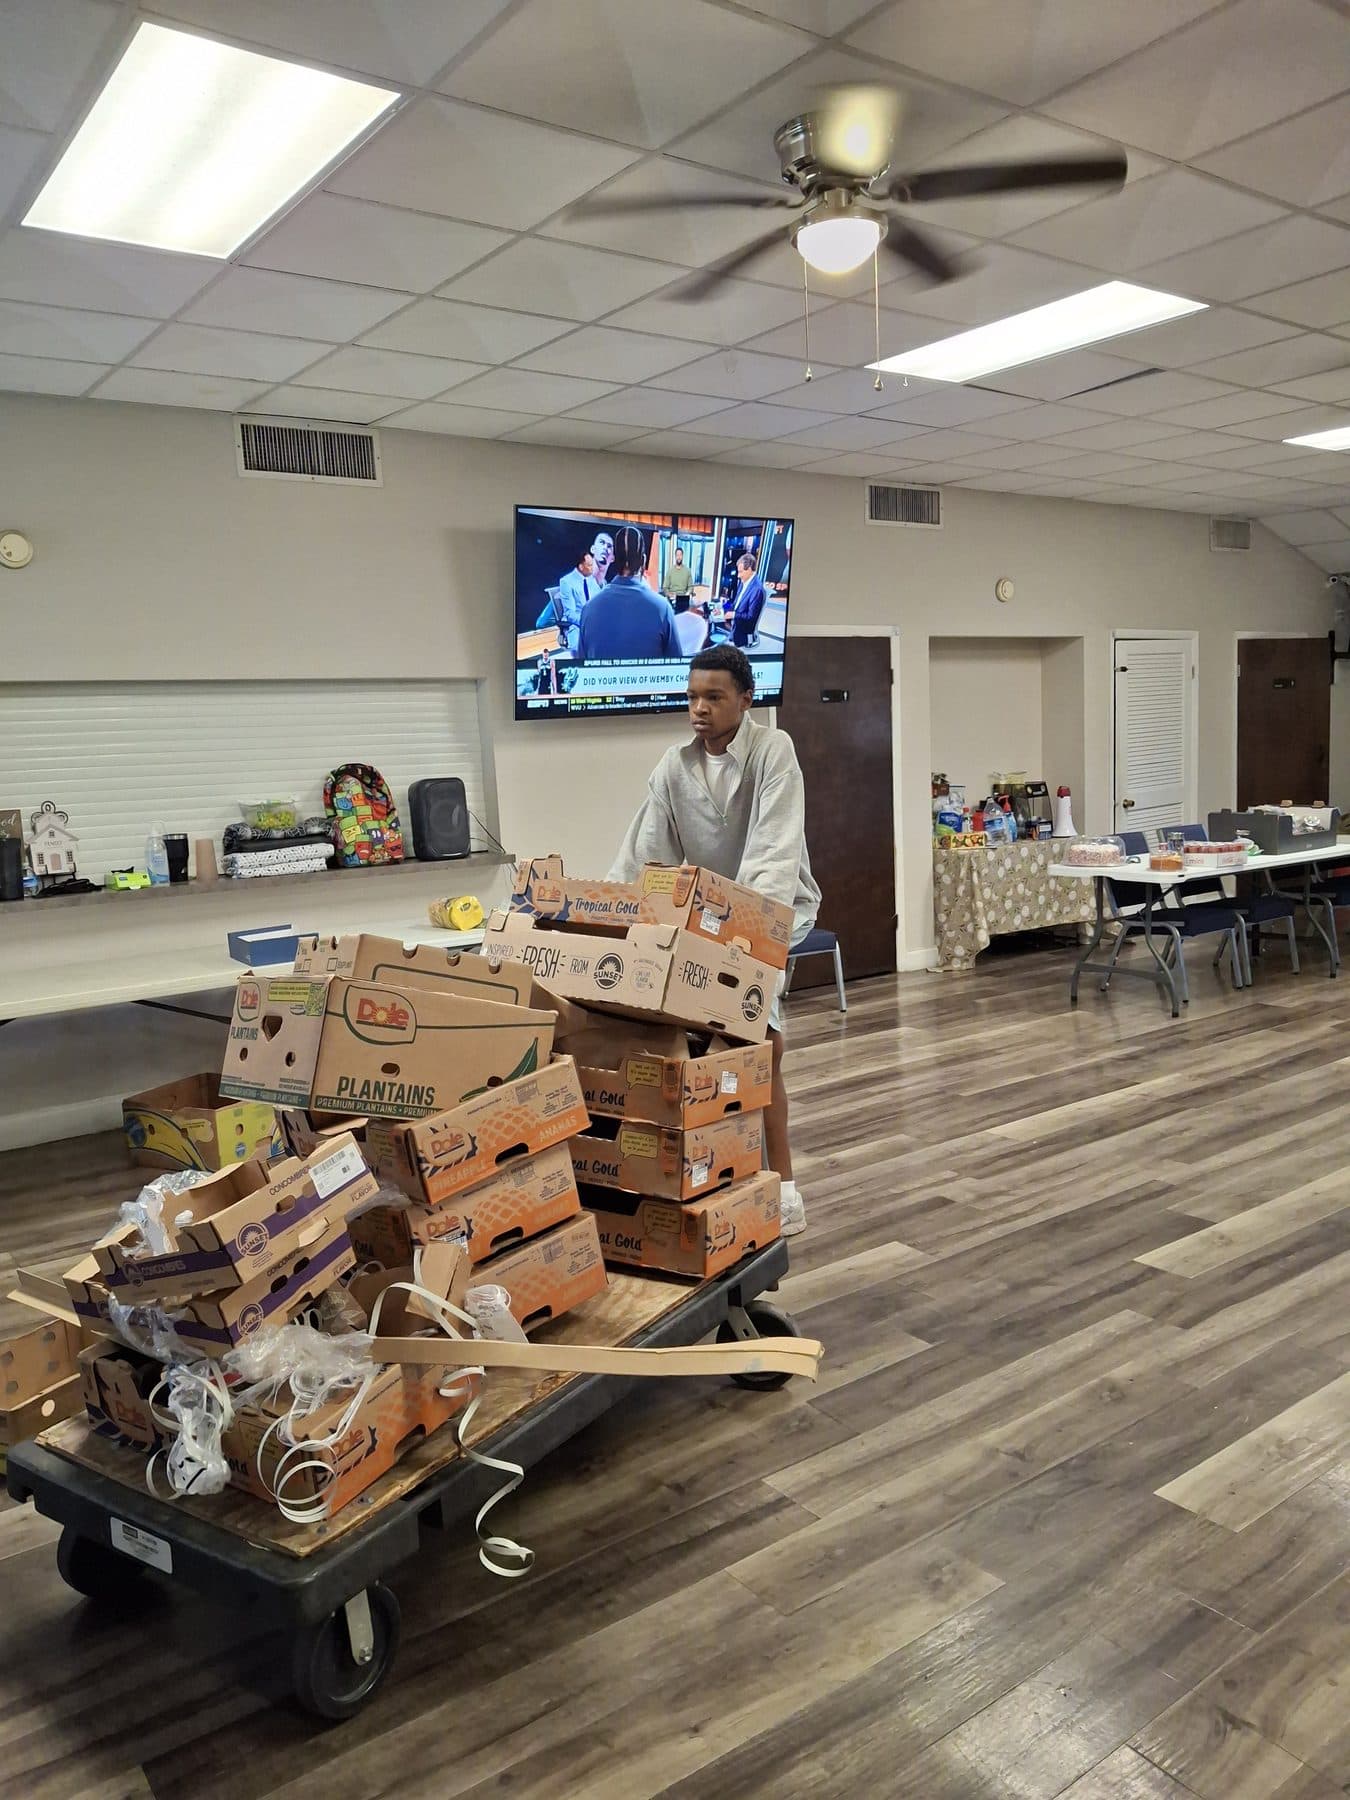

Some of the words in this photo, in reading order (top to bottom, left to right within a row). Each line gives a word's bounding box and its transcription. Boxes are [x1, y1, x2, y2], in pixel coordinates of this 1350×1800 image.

[583, 678, 596, 686] DID
[598, 677, 617, 685] YOUR
[619, 676, 637, 685] VIEW
[639, 676, 648, 684] OF
[650, 675, 673, 683] WEMBY
[538, 885, 561, 899] Dole
[575, 897, 612, 913] Tropical
[615, 900, 640, 915] Gold
[522, 945, 561, 979] FRESH
[569, 958, 589, 975] FROM
[593, 970, 623, 981] SUNSET
[682, 960, 709, 990] FRESH
[241, 989, 259, 1007] Dole
[741, 1001, 763, 1014] SUNSET
[356, 997, 410, 1027] Dole
[231, 1025, 259, 1041] PLANTAINS
[337, 1075, 436, 1106] PLANTAINS
[600, 1090, 625, 1106] Gold
[317, 1097, 355, 1110] PREMIUM
[355, 1101, 398, 1114] PLANTAINS
[539, 1115, 578, 1142] ANANAS
[430, 1131, 464, 1154] Dole
[592, 1159, 619, 1178] Gold
[426, 1214, 460, 1237] Dole
[240, 1231, 269, 1256] SUNSET
[615, 1233, 643, 1252] Gold
[227, 1456, 248, 1474] old
